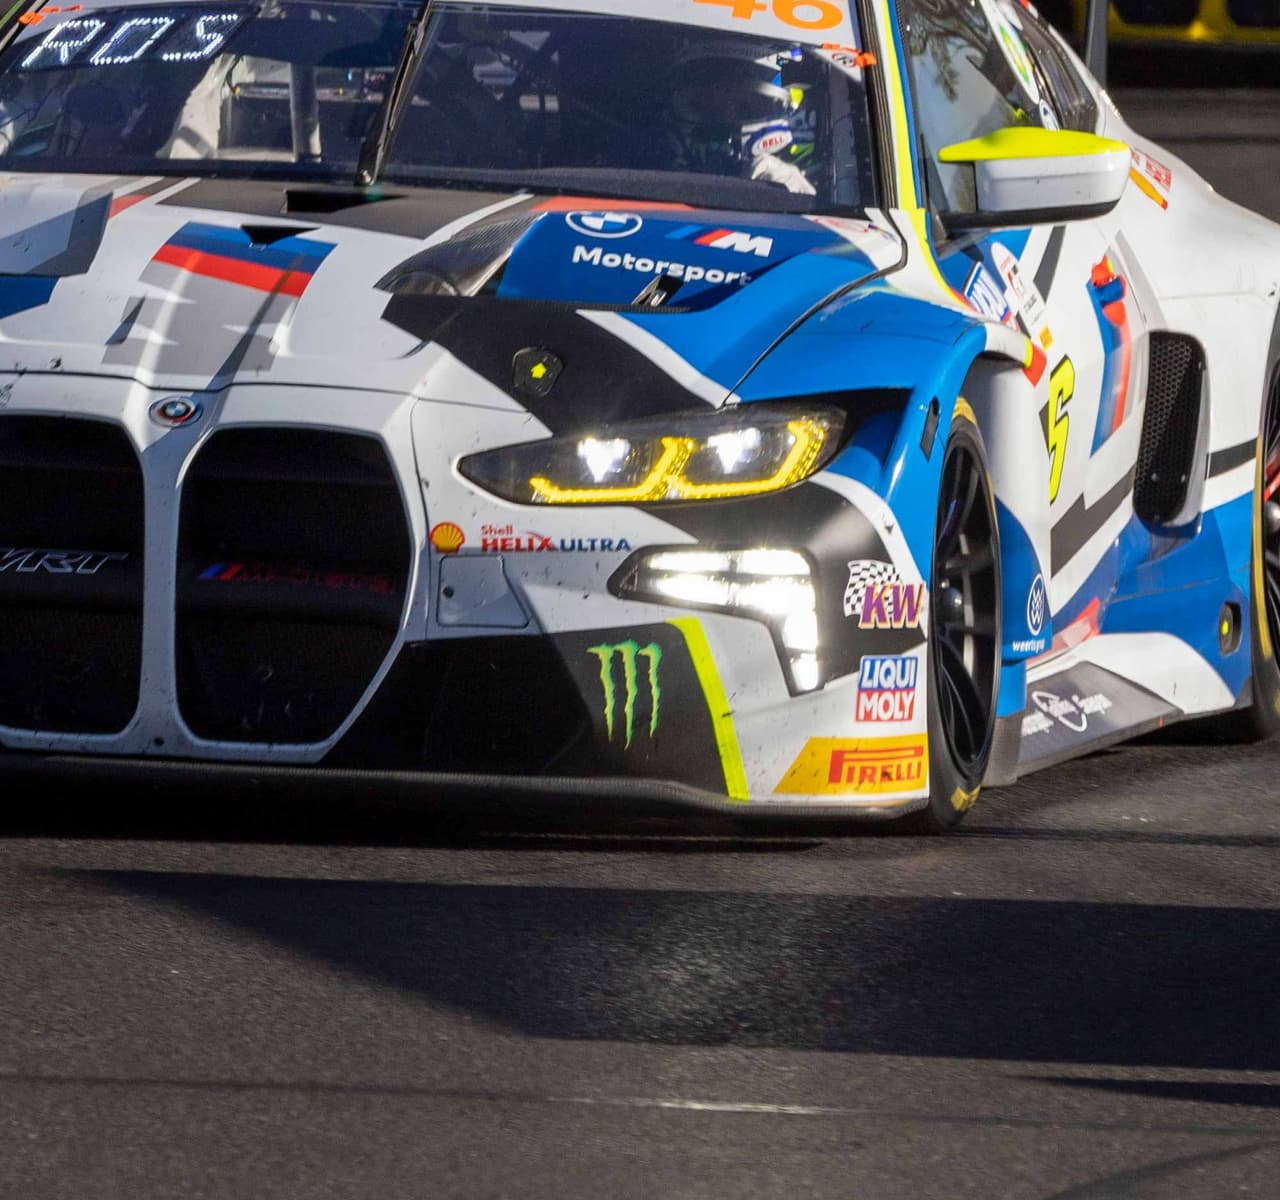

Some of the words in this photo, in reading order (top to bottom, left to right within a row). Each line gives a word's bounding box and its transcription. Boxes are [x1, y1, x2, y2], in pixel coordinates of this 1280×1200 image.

[20, 13, 242, 68] ROS
[571, 244, 752, 287] Motorsport
[481, 523, 514, 536] Shell
[481, 536, 556, 552] HELIX
[559, 537, 632, 552] ULTRA
[858, 583, 926, 629] KW
[861, 659, 917, 690] LIQUI
[858, 690, 915, 721] MOLY
[828, 746, 924, 785] PIRELLI
